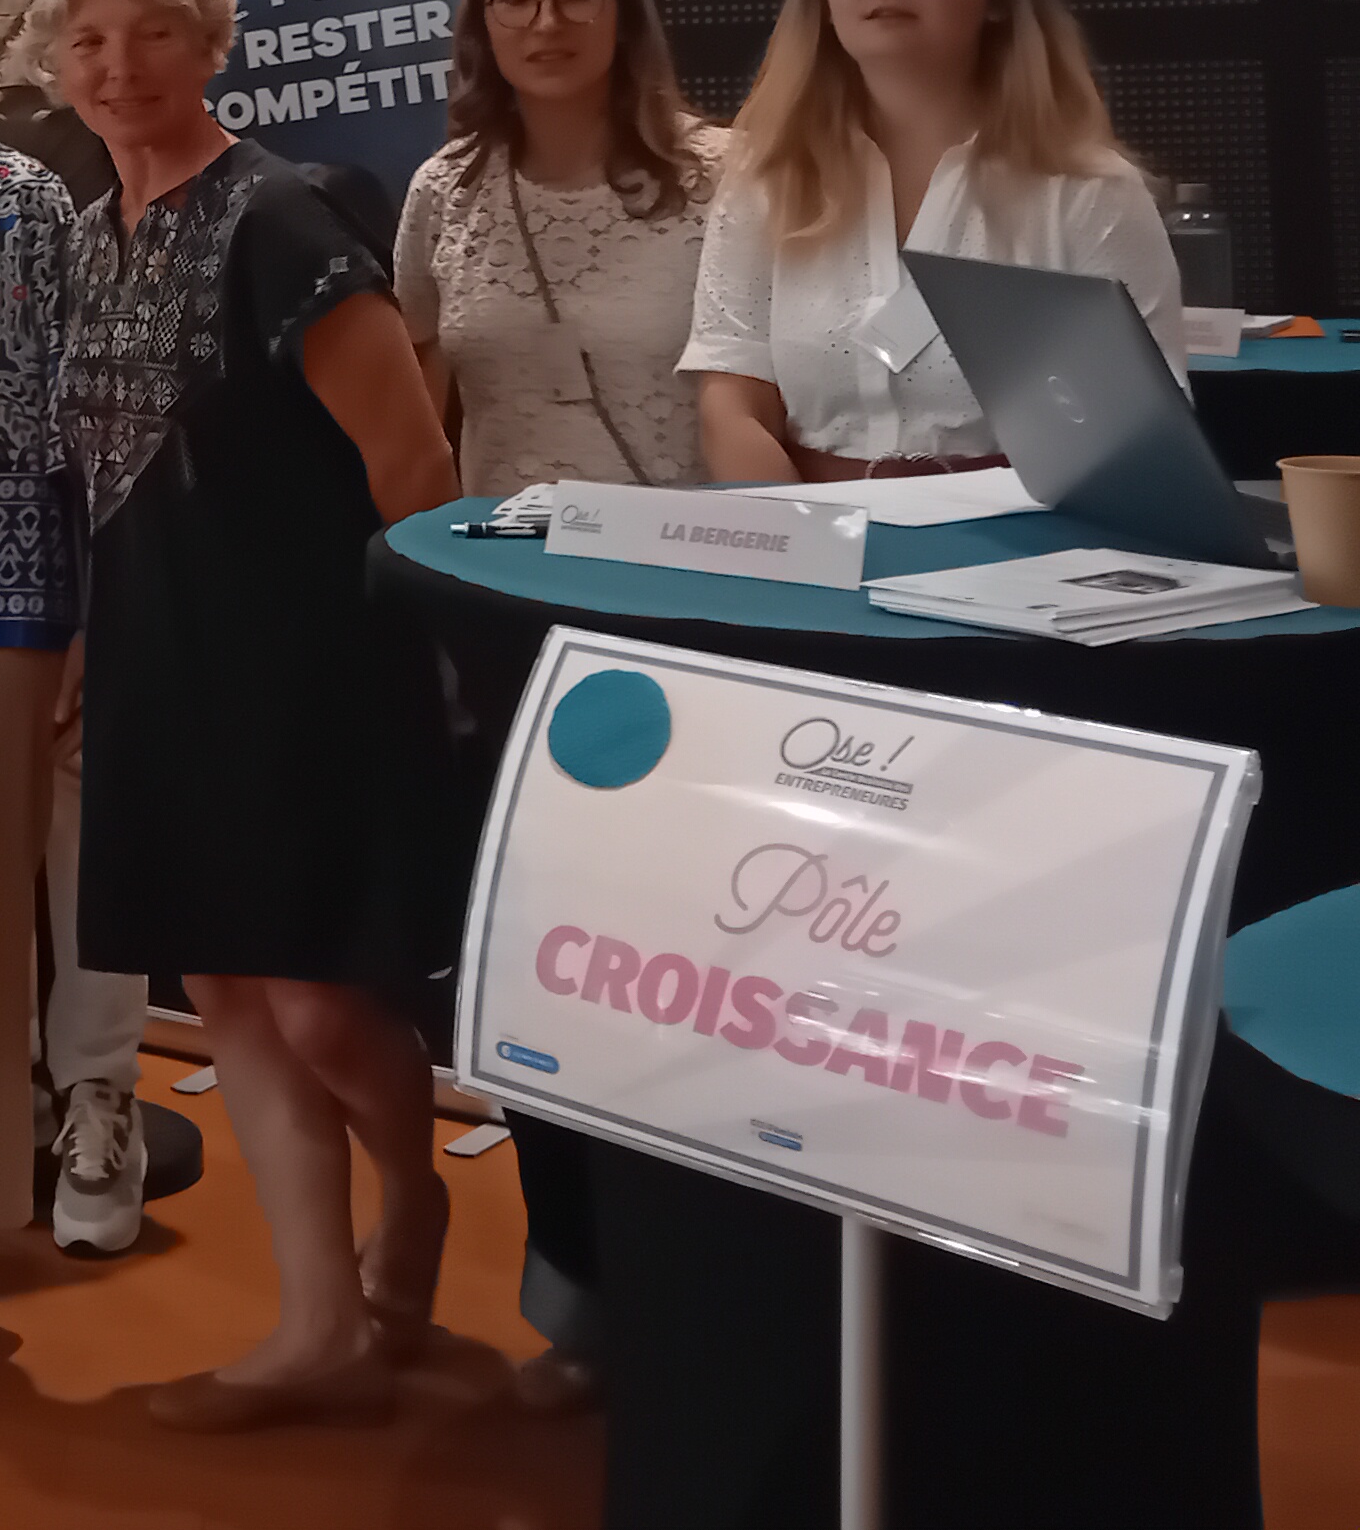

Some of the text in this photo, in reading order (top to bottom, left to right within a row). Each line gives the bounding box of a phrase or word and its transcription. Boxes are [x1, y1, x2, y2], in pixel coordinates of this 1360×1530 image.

[243, 0, 454, 70] RESTER
[202, 59, 455, 130] OMPÉTIT
[660, 522, 791, 553] LA BERGERIE
[780, 717, 916, 773] Ose !
[774, 772, 910, 812] ENTREPRENEURES
[713, 841, 903, 960] Pôle
[534, 924, 1086, 1139] CROISSANCE
